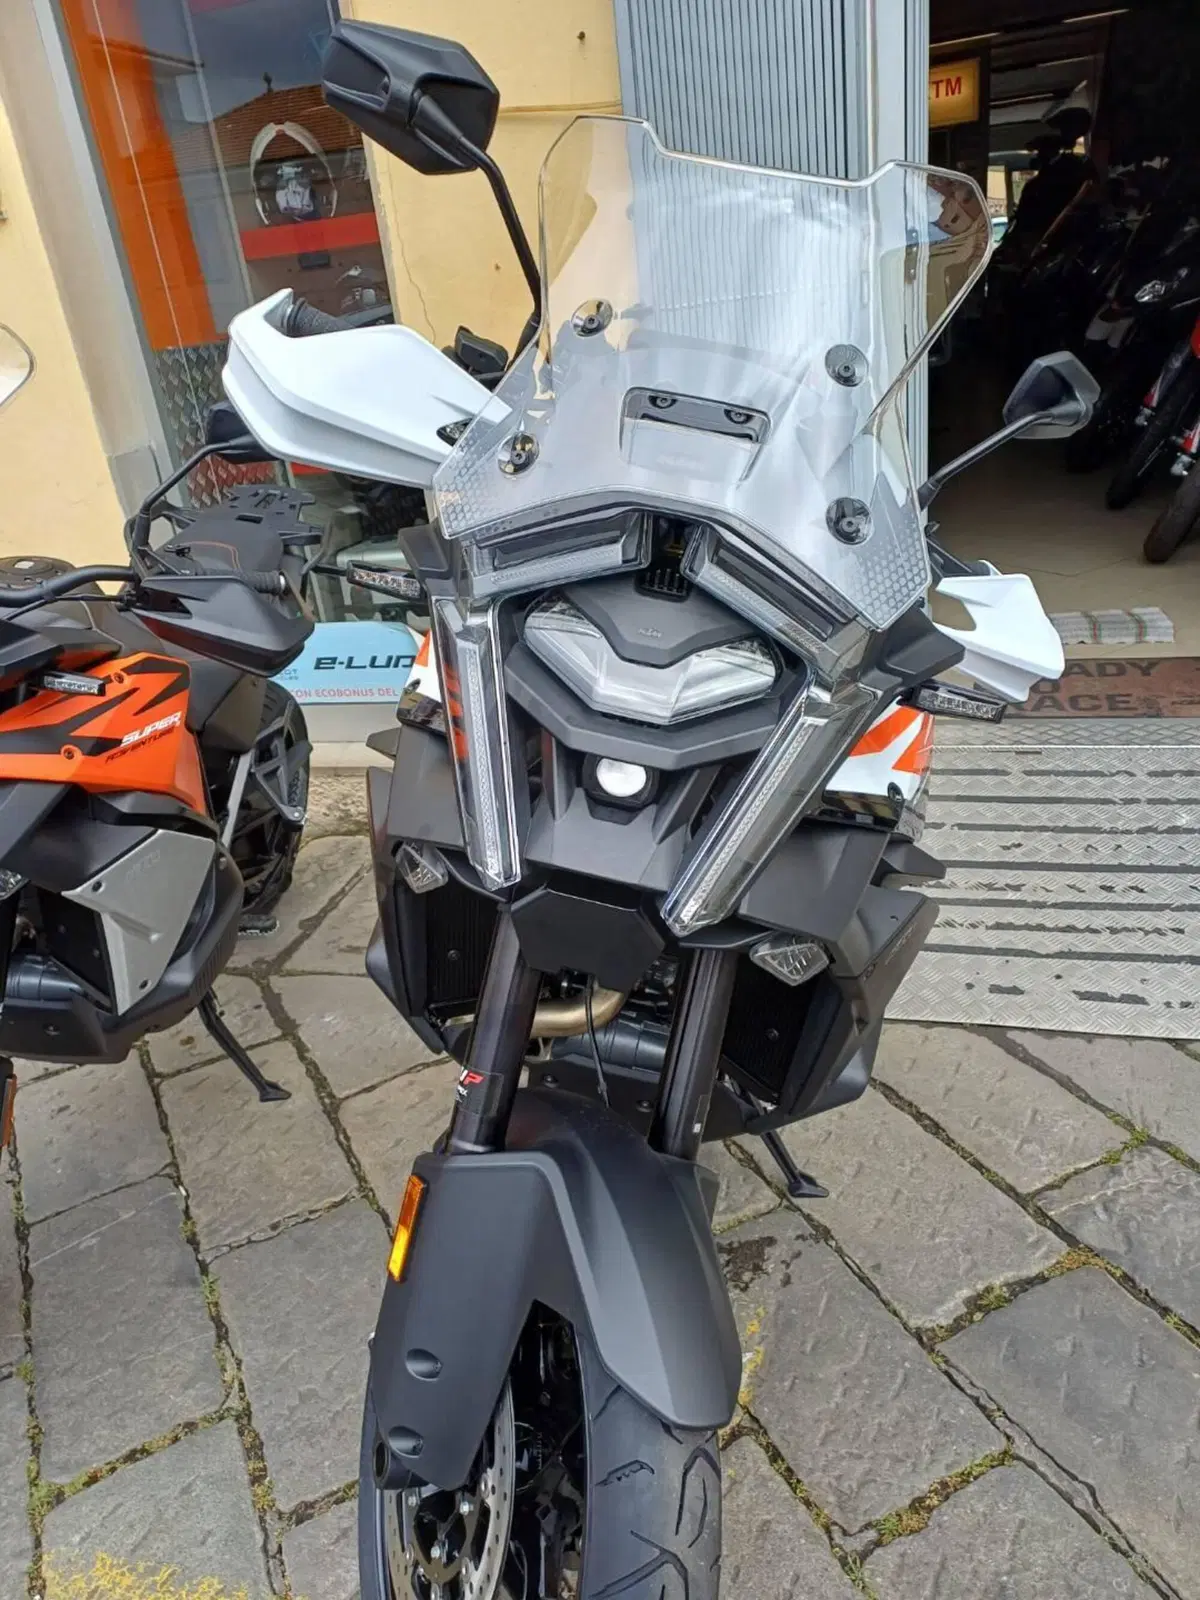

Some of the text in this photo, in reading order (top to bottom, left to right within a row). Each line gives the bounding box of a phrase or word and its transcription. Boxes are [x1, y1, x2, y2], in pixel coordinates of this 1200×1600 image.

[930, 77, 962, 99] TM
[1062, 661, 1161, 677] ADY
[315, 688, 374, 698] ECOBONUS
[378, 687, 398, 697] DEL
[1016, 694, 1140, 711] ACE
[120, 711, 182, 748] SUPER
